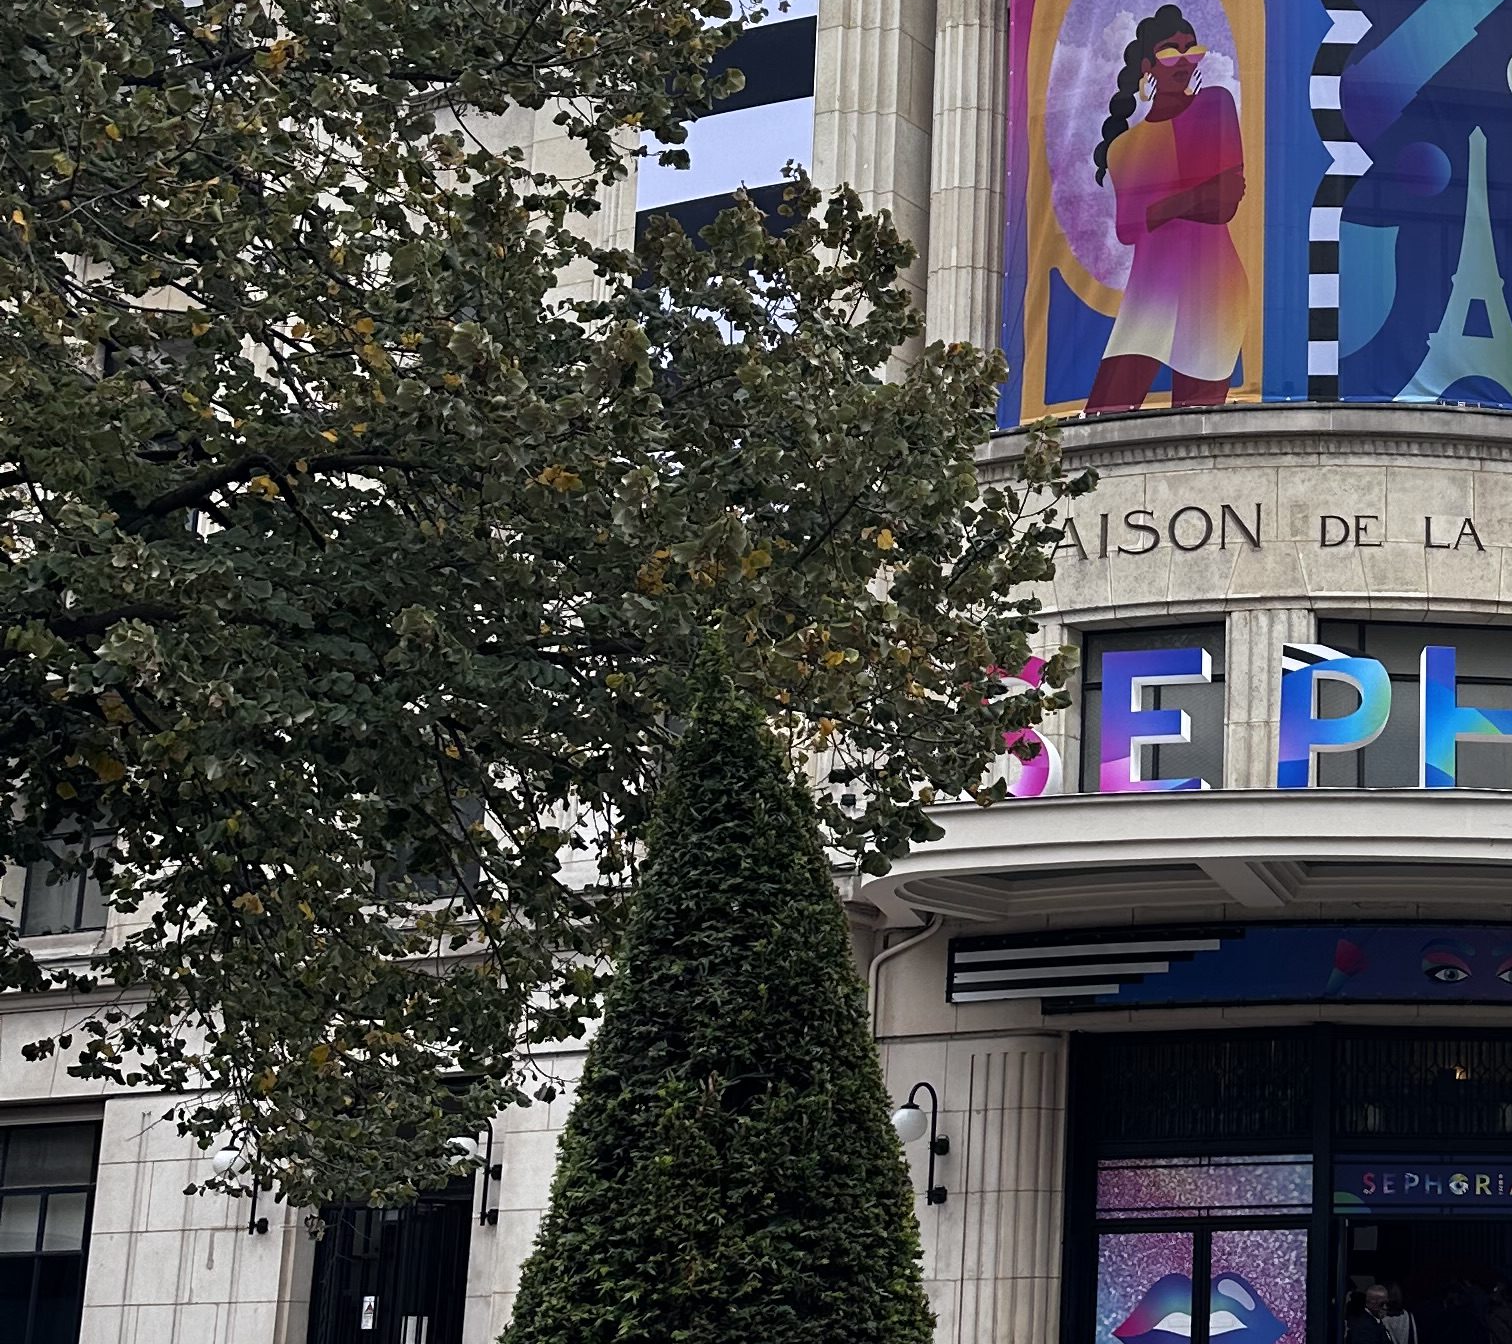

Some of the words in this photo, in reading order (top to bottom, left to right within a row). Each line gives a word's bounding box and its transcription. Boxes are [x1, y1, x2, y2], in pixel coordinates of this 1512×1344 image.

[1046, 502, 1263, 561] AISON
[1319, 515, 1384, 548] DE
[1424, 515, 1487, 552] LA
